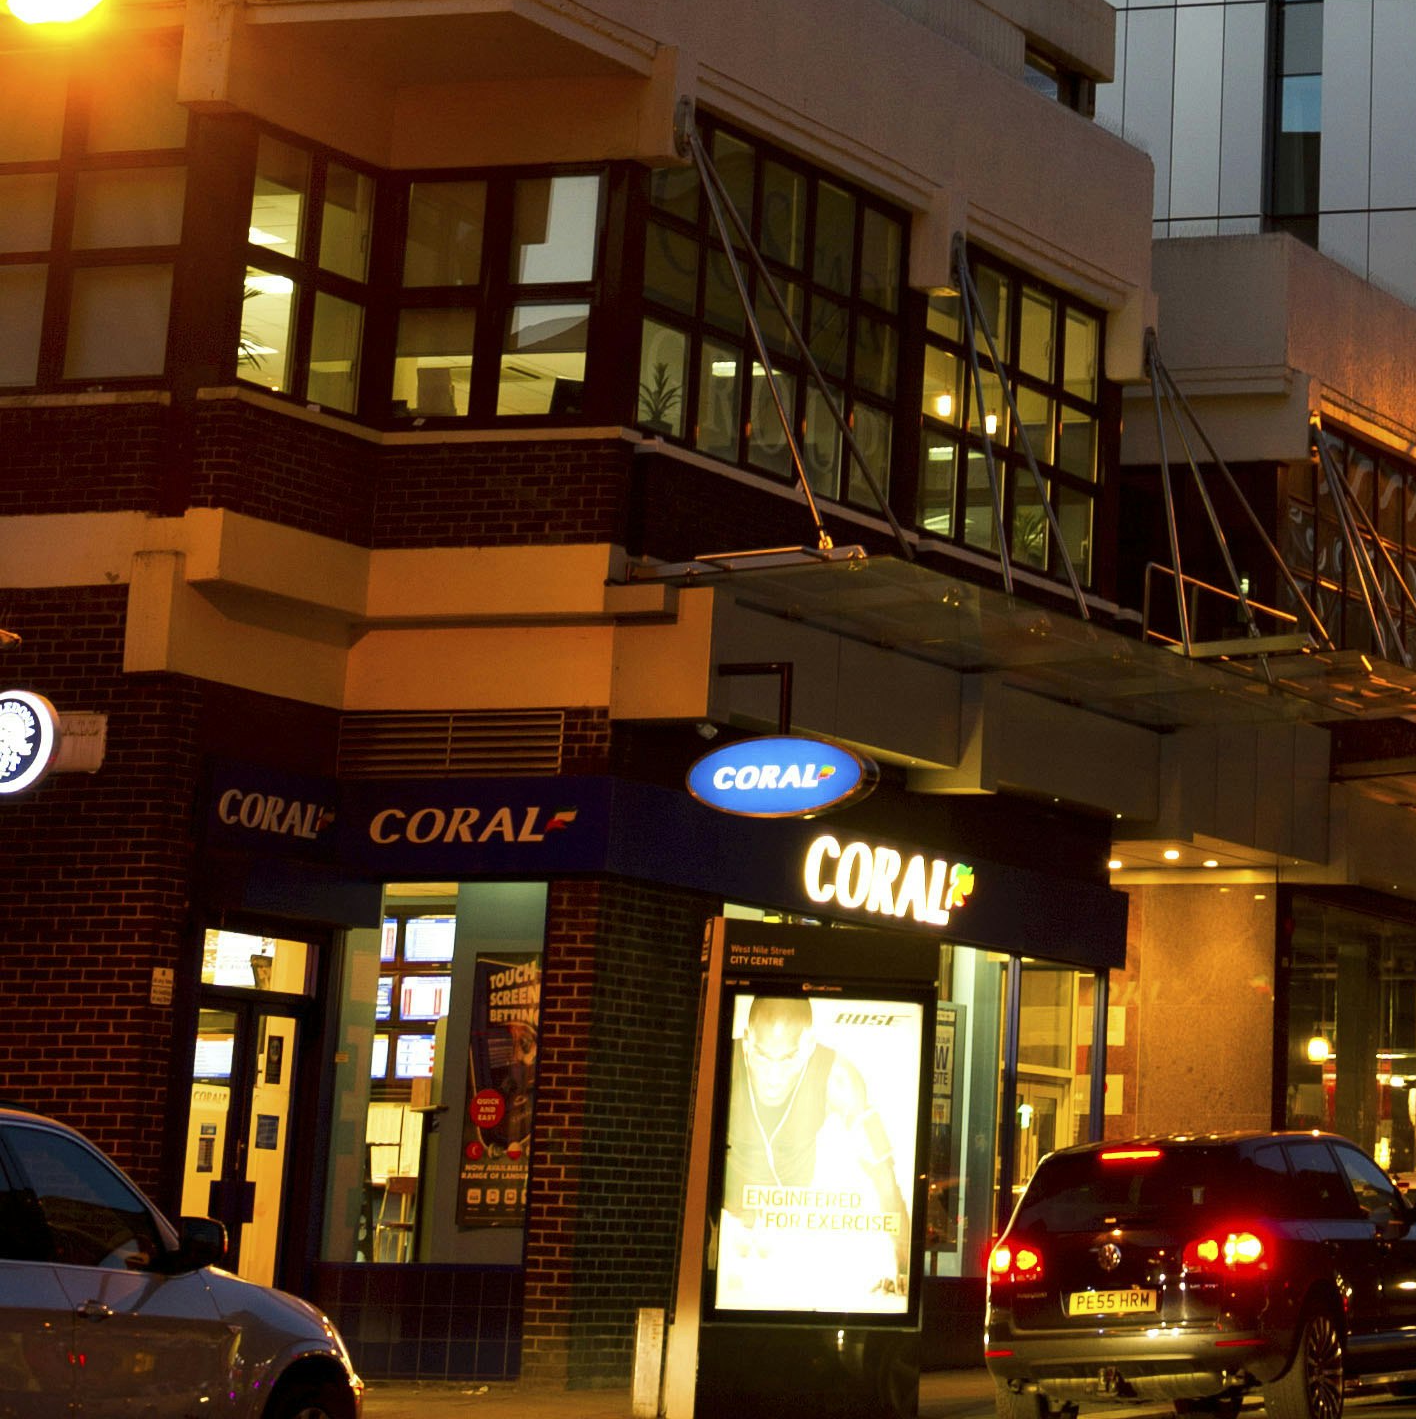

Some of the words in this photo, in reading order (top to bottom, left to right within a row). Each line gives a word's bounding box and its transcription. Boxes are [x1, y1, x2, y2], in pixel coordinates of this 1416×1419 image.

[713, 764, 819, 790] CORAL
[218, 789, 318, 839] CORAL
[369, 806, 545, 844] CORAL
[804, 835, 950, 926] CORAL
[730, 955, 749, 964] CITY
[750, 956, 784, 966] CENTRE
[731, 944, 750, 953] West
[752, 945, 768, 954] Nile
[770, 946, 795, 956] Street
[490, 960, 537, 990] TOUCH
[490, 984, 541, 1006] SCREEN
[746, 1188, 862, 1209] ENGINEERED
[765, 1212, 800, 1228] FOR
[807, 1213, 898, 1233] EXERCISE.
[1076, 1295, 1115, 1311] PE55
[1119, 1292, 1150, 1309] HRM
